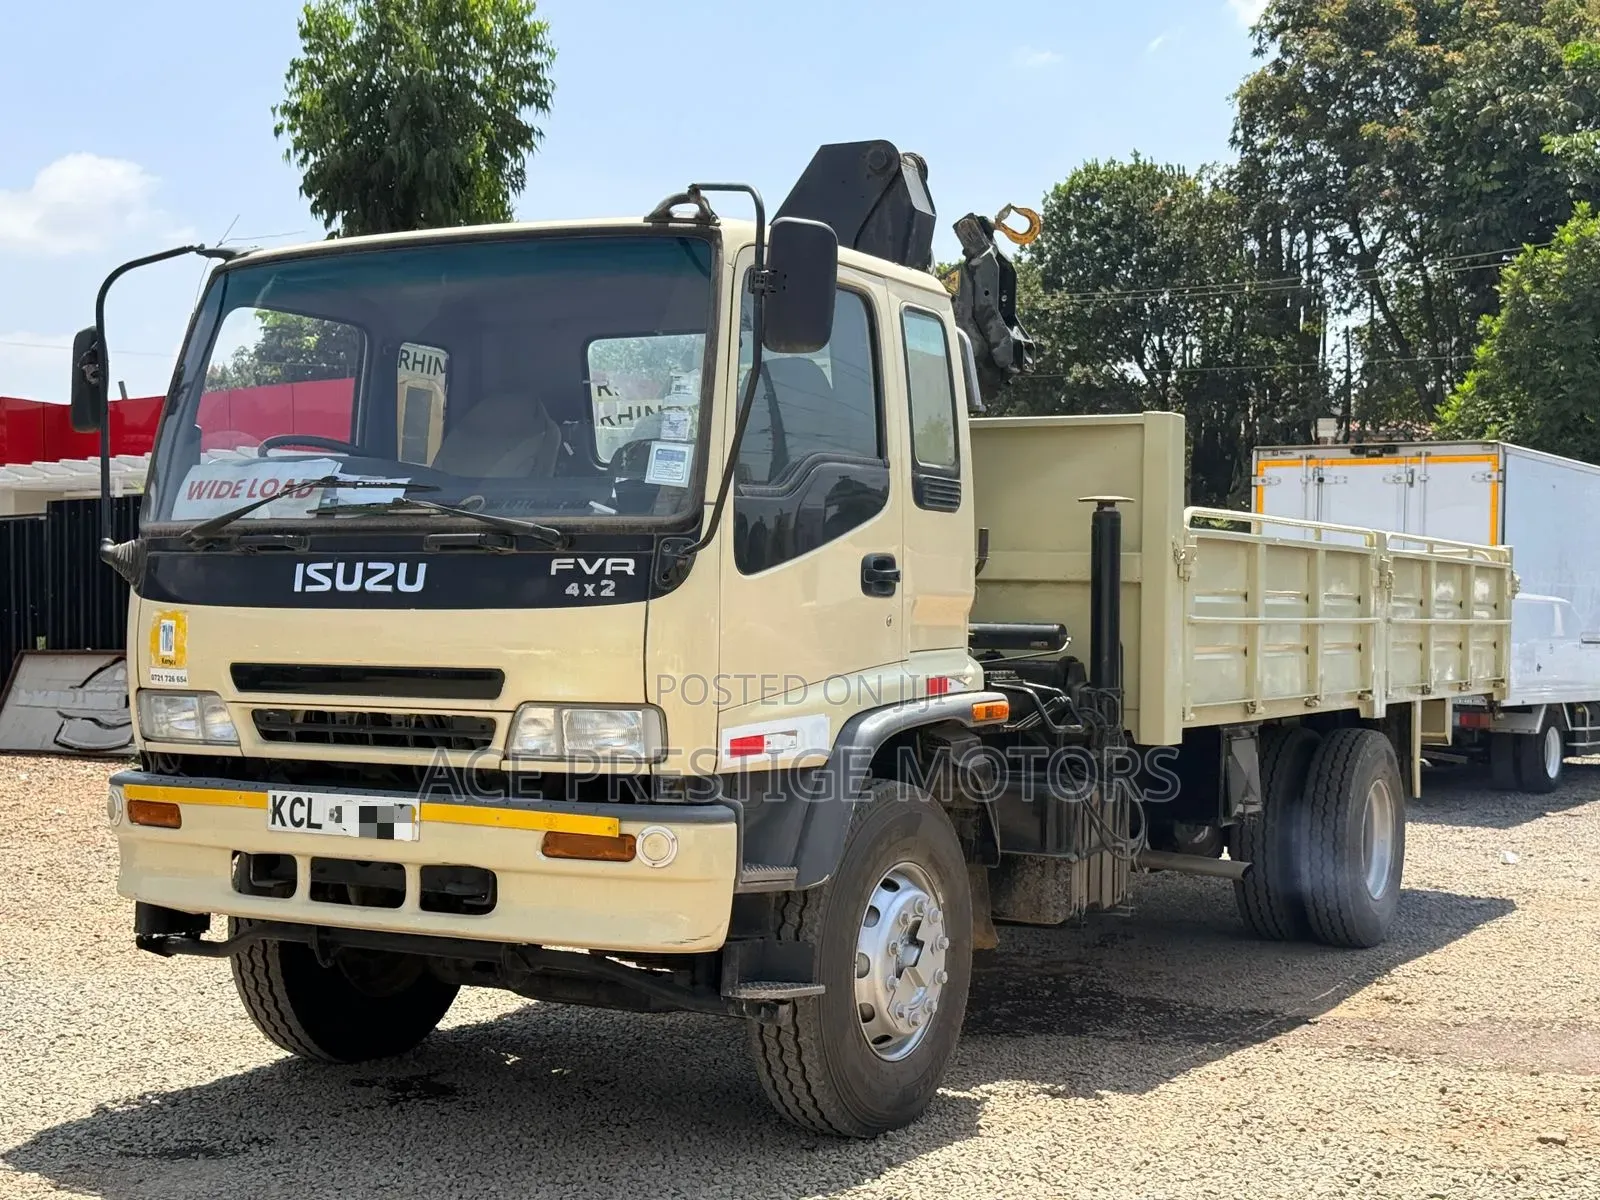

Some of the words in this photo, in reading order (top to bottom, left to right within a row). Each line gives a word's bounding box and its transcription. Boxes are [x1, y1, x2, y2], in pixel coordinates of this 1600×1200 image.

[186, 479, 246, 500] WIDE
[293, 561, 427, 593] ISUZU
[550, 558, 635, 576] FVR
[271, 795, 323, 830] KCL
